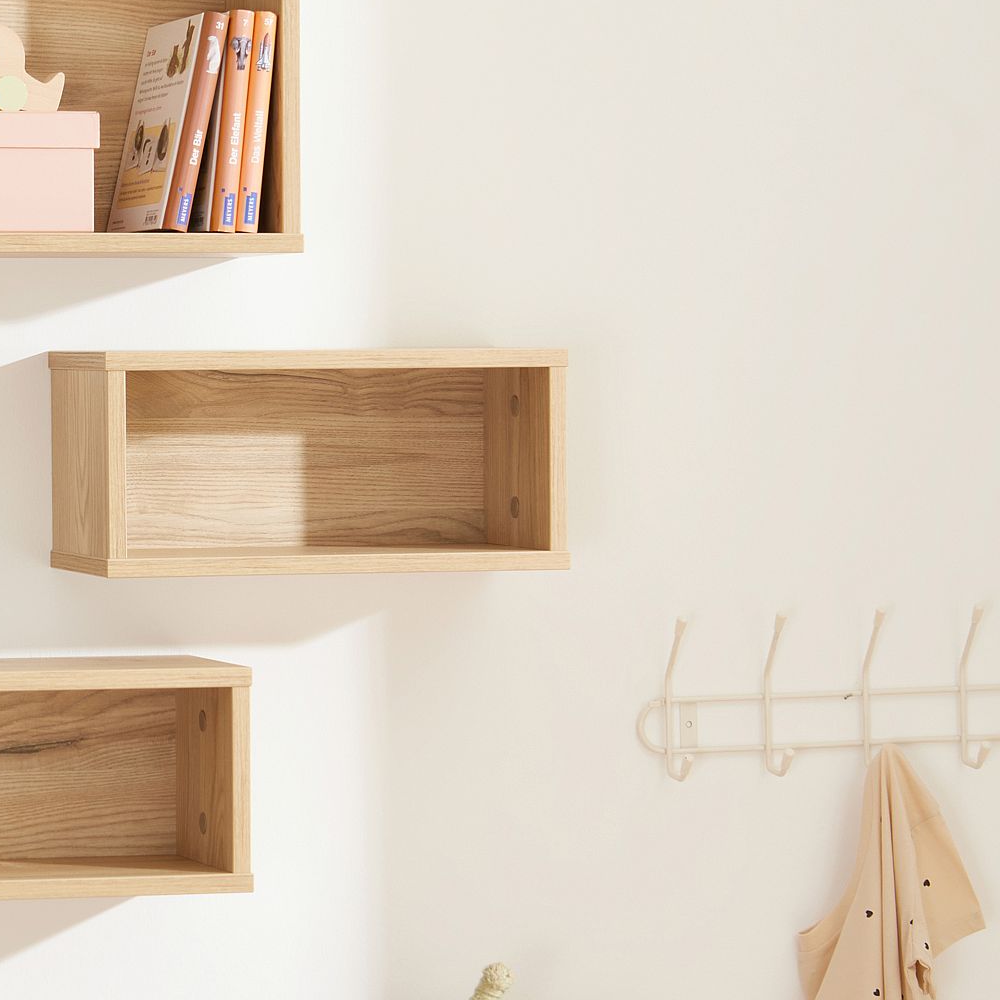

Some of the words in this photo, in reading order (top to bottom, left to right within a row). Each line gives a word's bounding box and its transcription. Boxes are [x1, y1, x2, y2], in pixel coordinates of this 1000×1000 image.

[215, 21, 225, 31] 31
[230, 112, 241, 146] Elefant
[189, 148, 200, 166] Der
[229, 147, 239, 165] Der
[250, 146, 261, 164] Das
